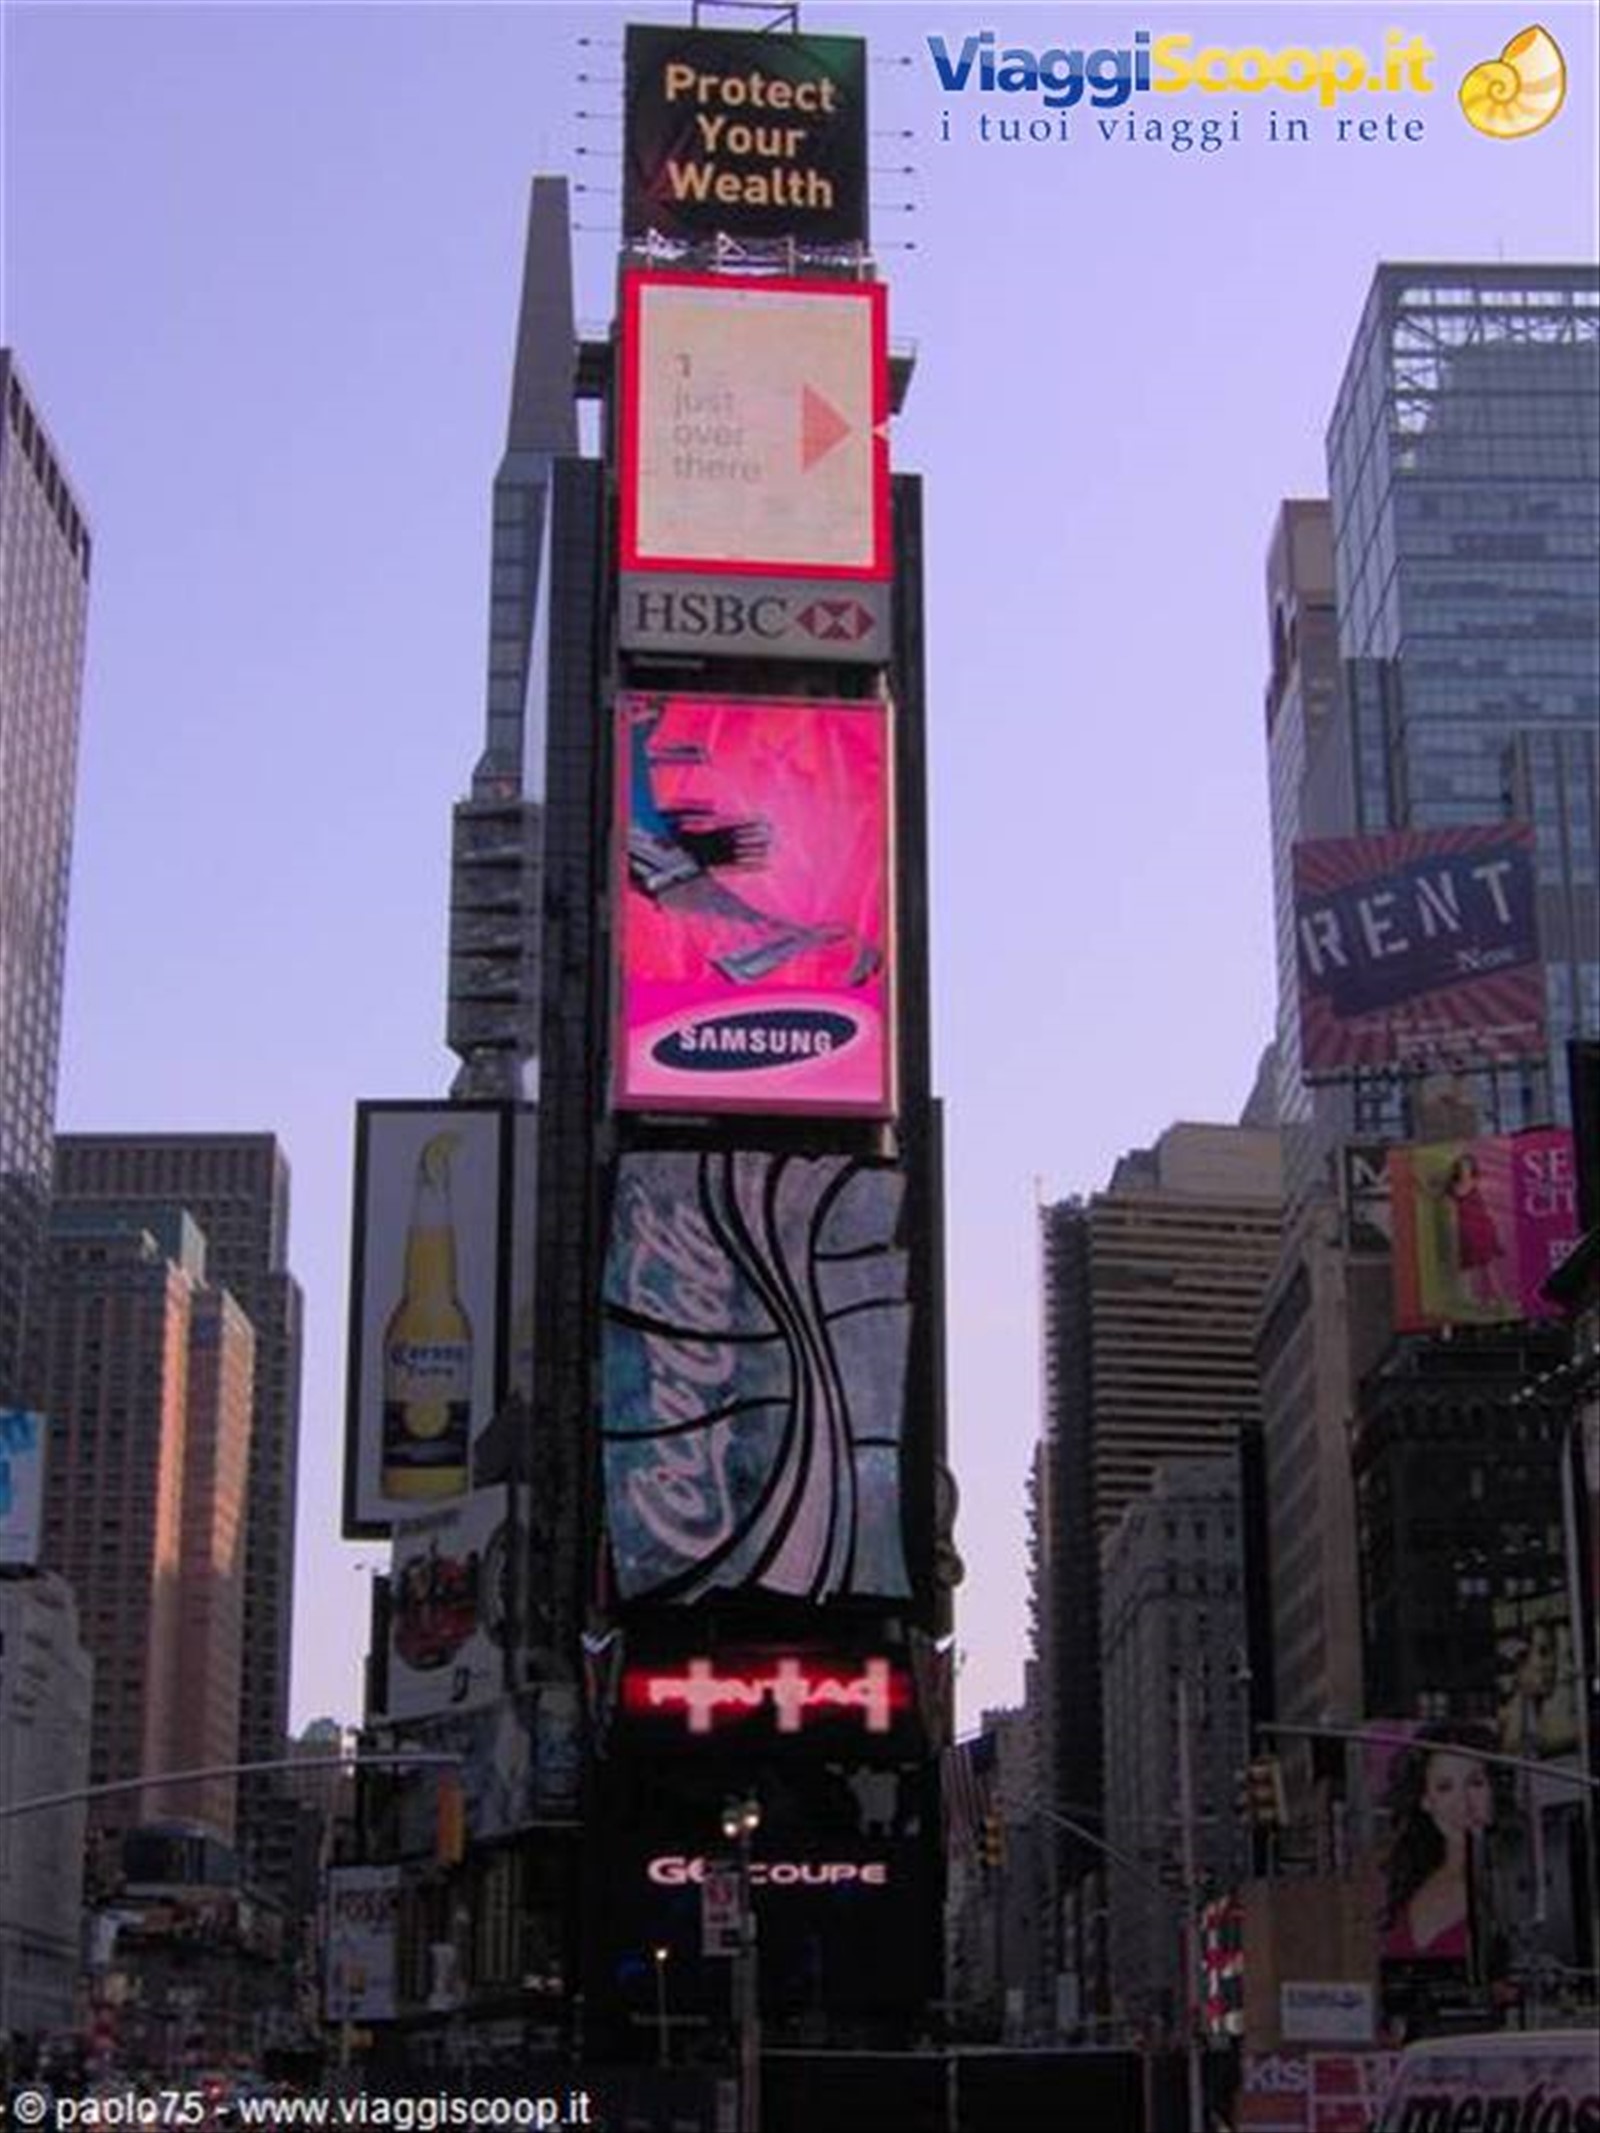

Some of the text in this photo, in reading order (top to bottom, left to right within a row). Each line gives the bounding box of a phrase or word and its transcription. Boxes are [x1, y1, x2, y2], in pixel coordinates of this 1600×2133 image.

[665, 63, 836, 113] Protect
[696, 113, 807, 157] Your
[667, 160, 833, 208] Wealth
[674, 383, 734, 419] just
[673, 424, 744, 447] over
[673, 452, 763, 483] there
[635, 591, 789, 639] HSBC
[1300, 861, 1513, 977] RENT
[678, 1026, 834, 1056] SAMSUNG
